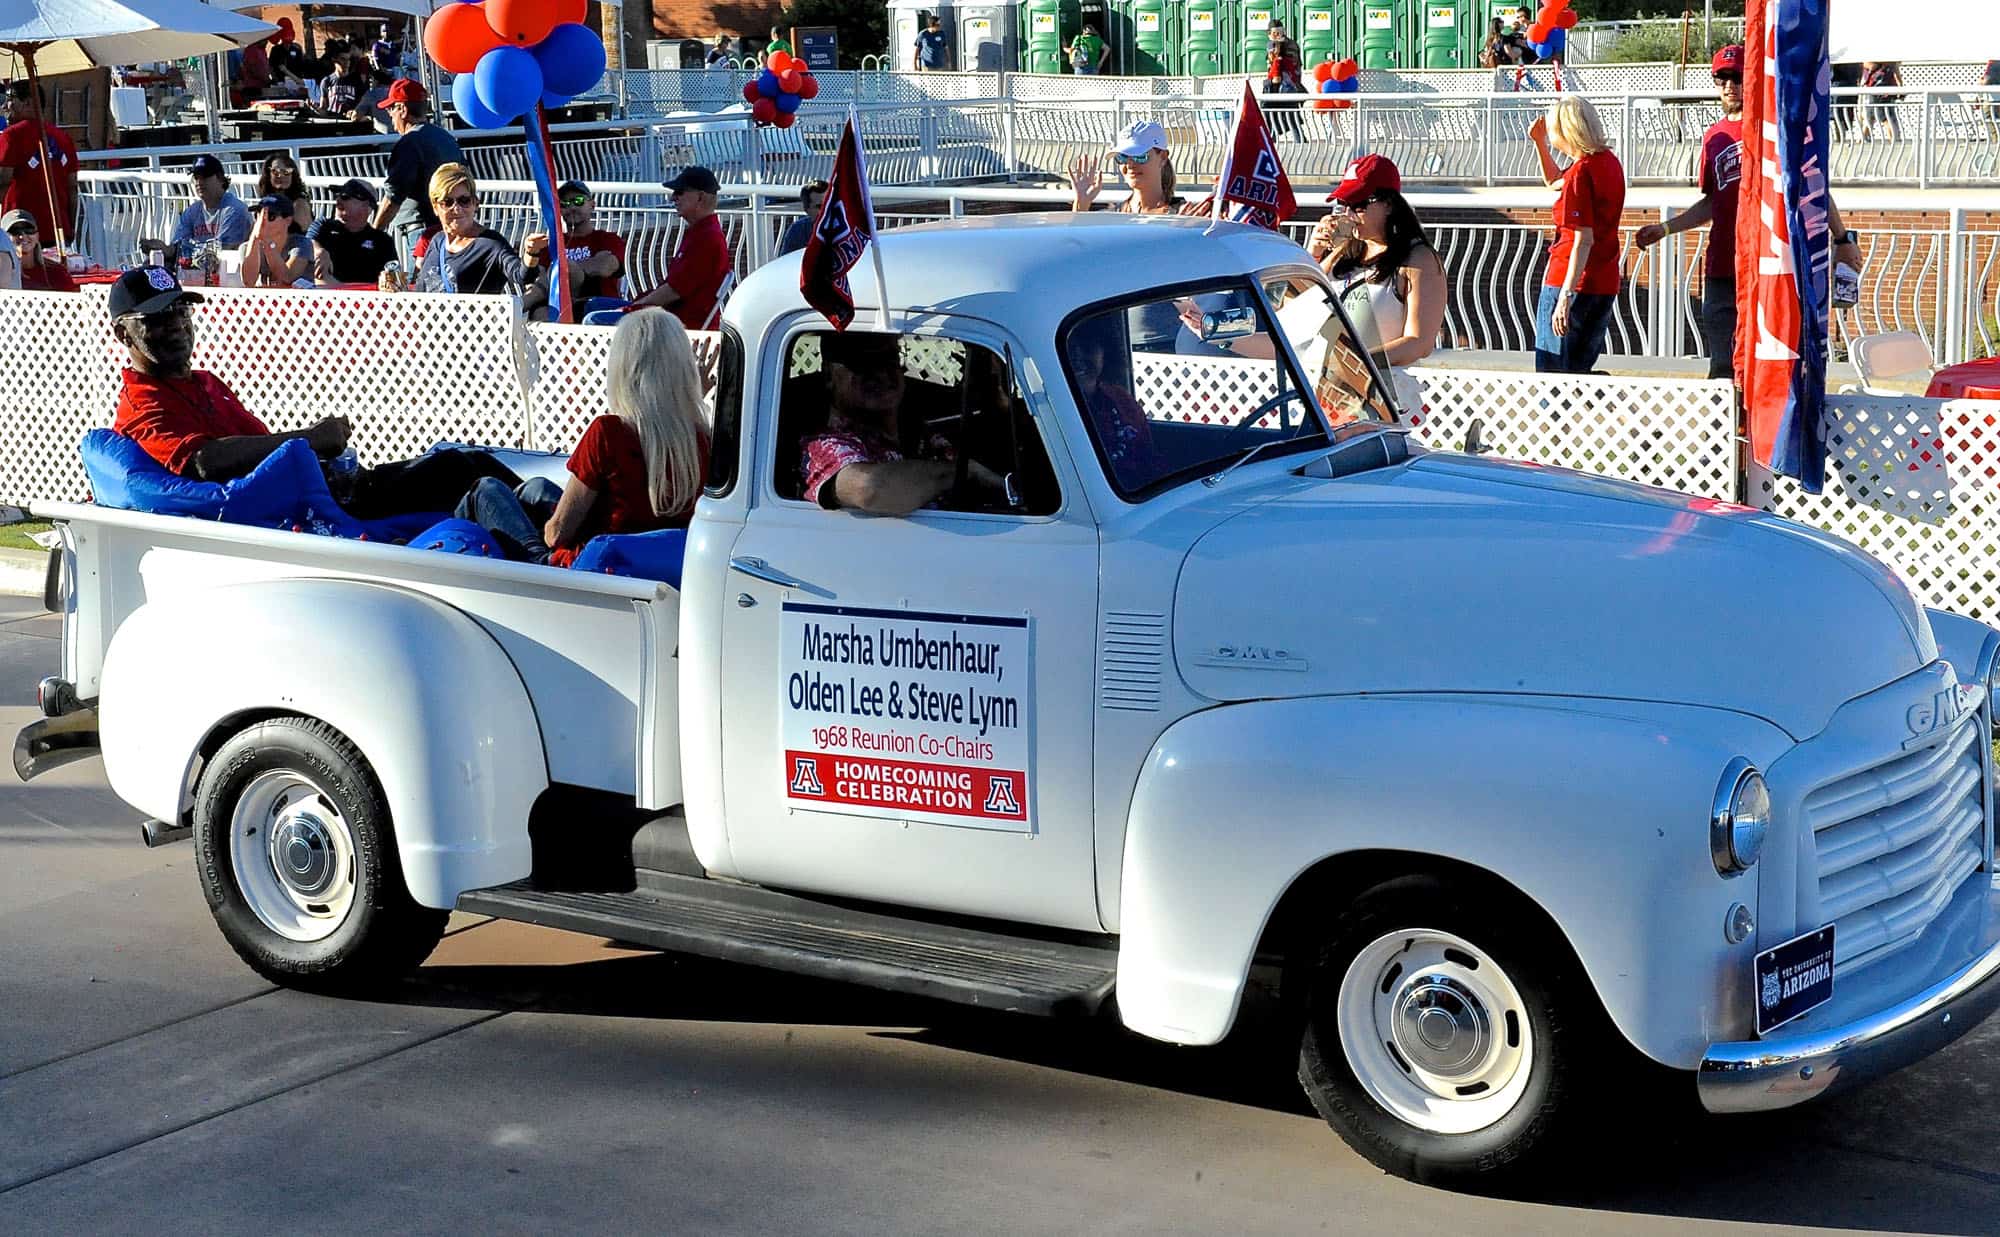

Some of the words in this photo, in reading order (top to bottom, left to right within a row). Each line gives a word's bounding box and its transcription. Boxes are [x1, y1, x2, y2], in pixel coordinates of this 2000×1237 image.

[802, 623, 875, 666] Marsha
[880, 627, 1003, 683] Umbenhaur,
[1217, 646, 1289, 660] GMC
[788, 670, 845, 714] Olden
[850, 677, 884, 717] Lee
[887, 680, 904, 719] &
[908, 682, 964, 724] Steve
[969, 686, 1018, 737] Lynn
[812, 725, 848, 750] 1968
[852, 728, 915, 753] Reunion
[919, 733, 994, 761] Co-Chairs
[835, 760, 972, 790] HOMECOMING
[835, 780, 973, 810] CELEBRATION
[1782, 961, 1831, 999] ARIZONA
